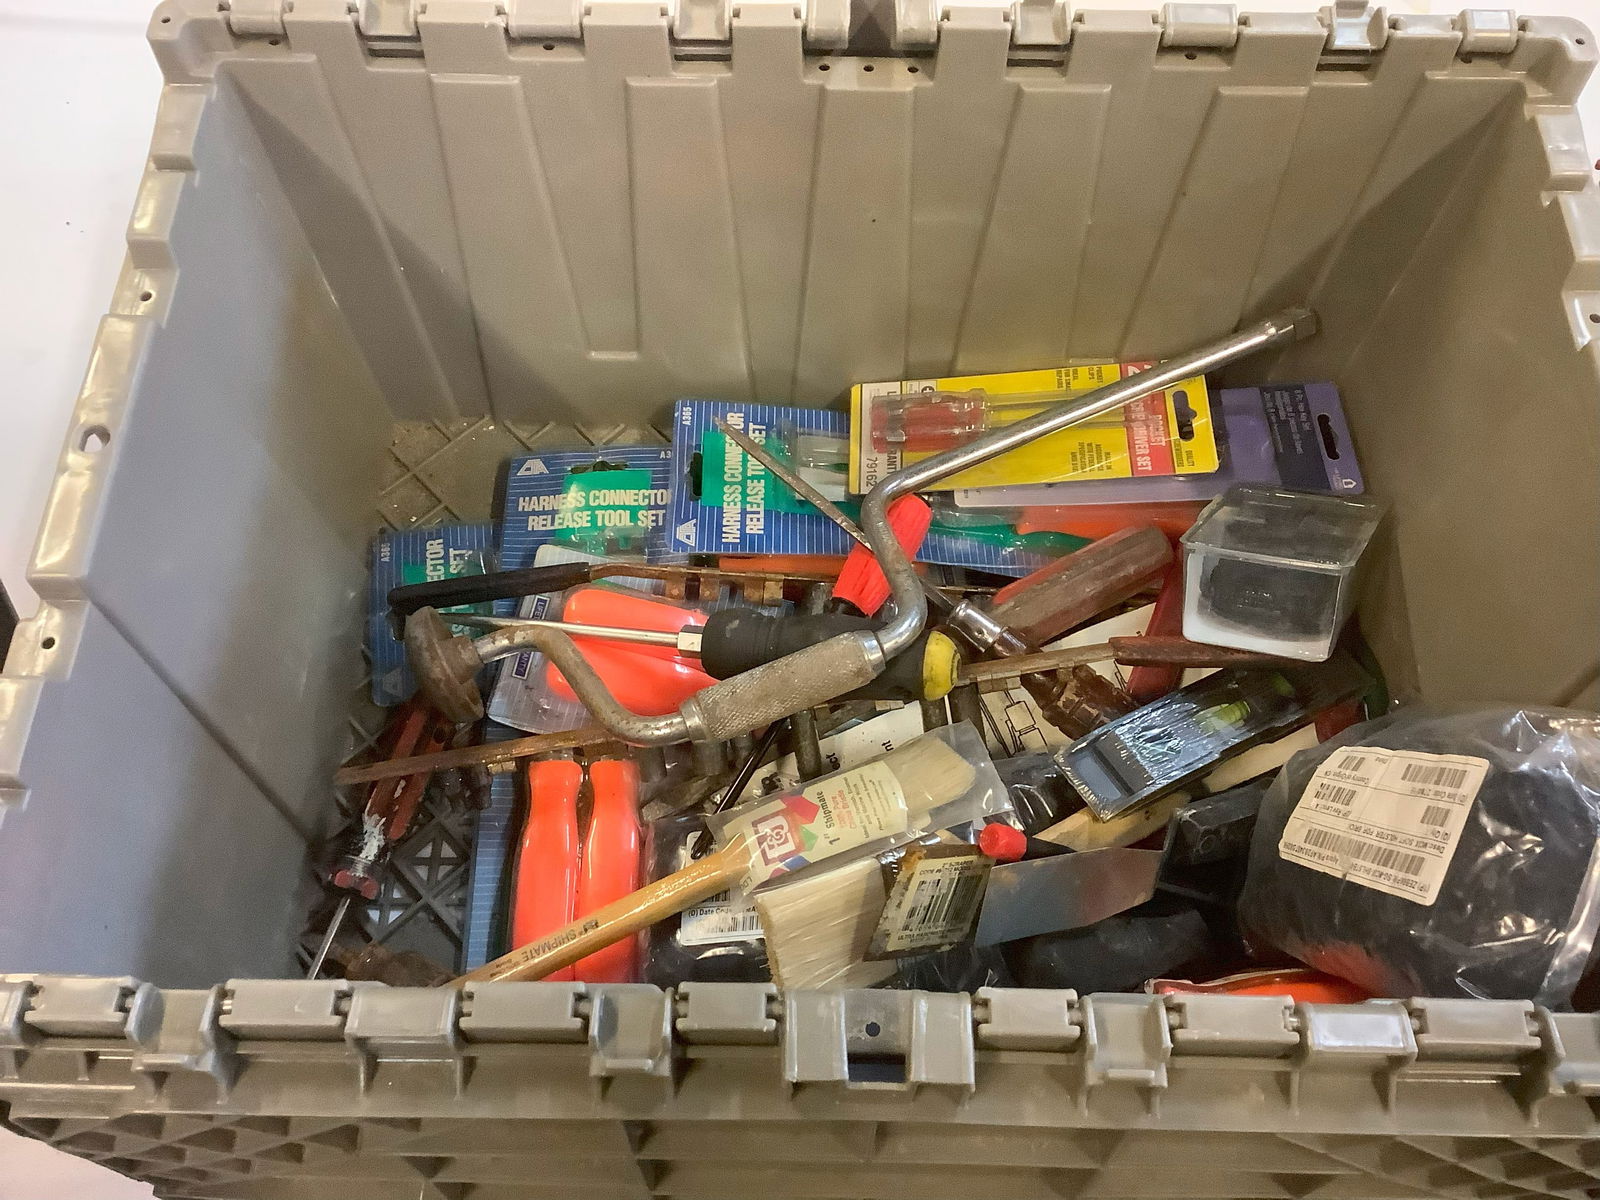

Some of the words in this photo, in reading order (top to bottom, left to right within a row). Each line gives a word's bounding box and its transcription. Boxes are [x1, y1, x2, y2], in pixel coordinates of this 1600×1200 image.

[682, 406, 692, 426] A365
[749, 422, 767, 445] SET
[659, 450, 672, 459] A3
[724, 412, 744, 482] CONNEOR
[866, 457, 878, 488] 79162
[1136, 456, 1152, 471] SET
[518, 491, 586, 511] HARNESS
[746, 479, 765, 534] RELEASE
[528, 511, 592, 531] RELEASE
[595, 510, 634, 527] TOOL
[637, 510, 666, 527] SET
[722, 484, 742, 543] HARNESS
[816, 791, 835, 829] Shipmate
[699, 908, 714, 916] Date
[521, 929, 577, 962] SHIPMATE
